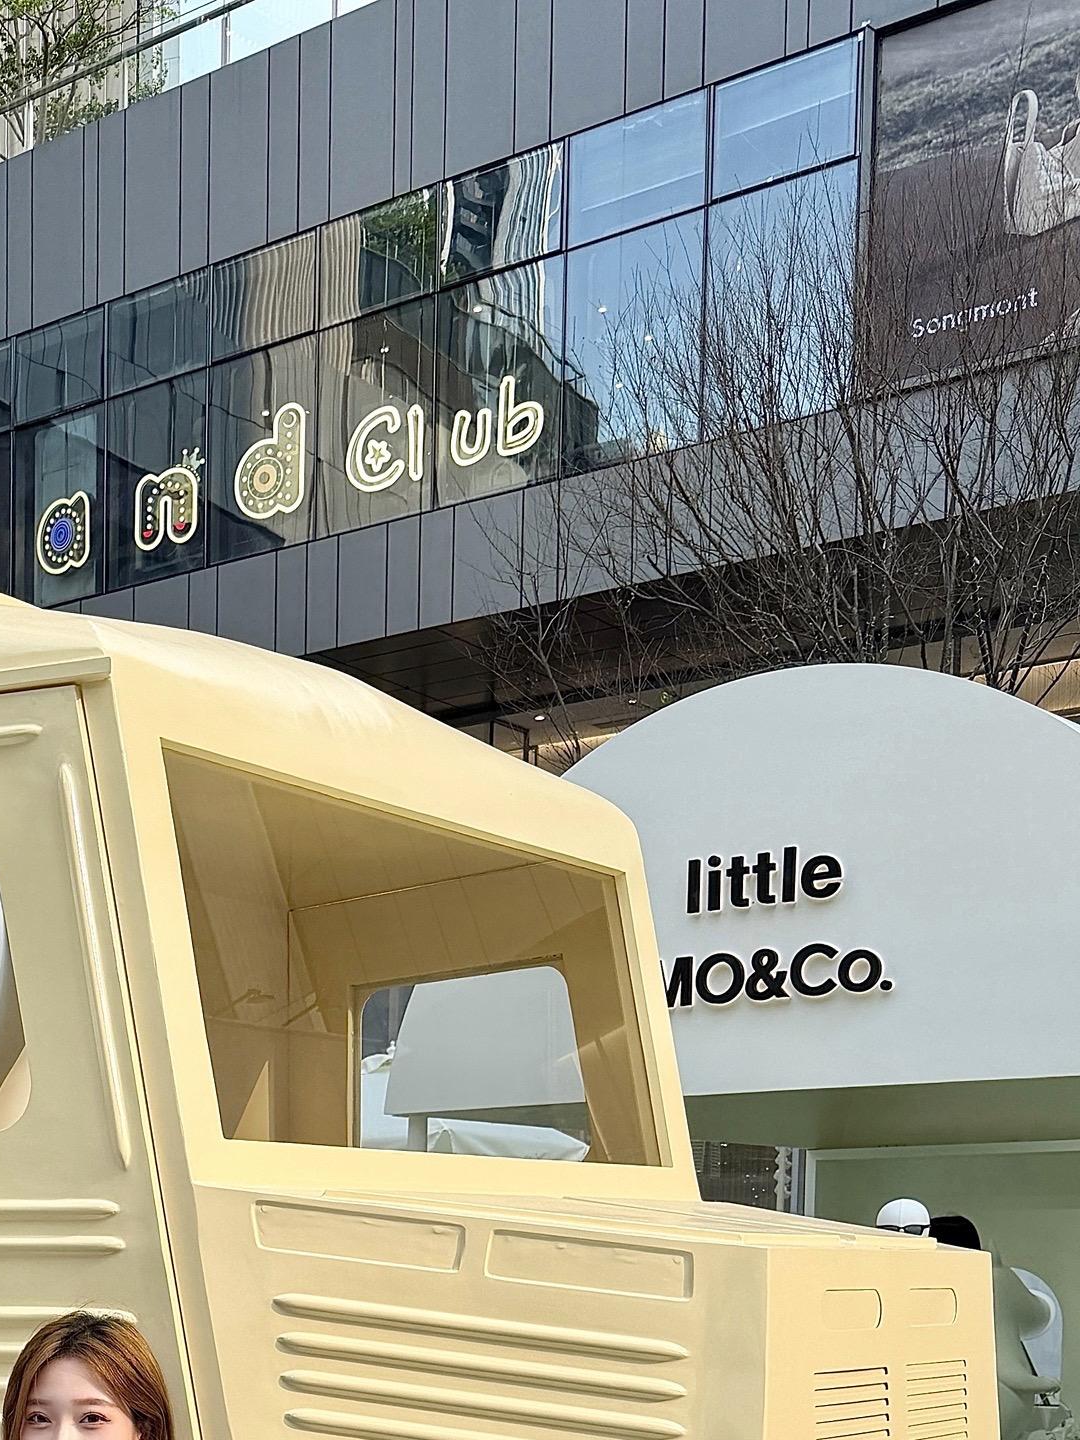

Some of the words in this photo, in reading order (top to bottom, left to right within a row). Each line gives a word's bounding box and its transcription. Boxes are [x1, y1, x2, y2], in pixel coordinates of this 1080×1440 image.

[346, 376, 545, 492] Club
[686, 846, 843, 914] little
[660, 943, 893, 1008] MO&Co.
